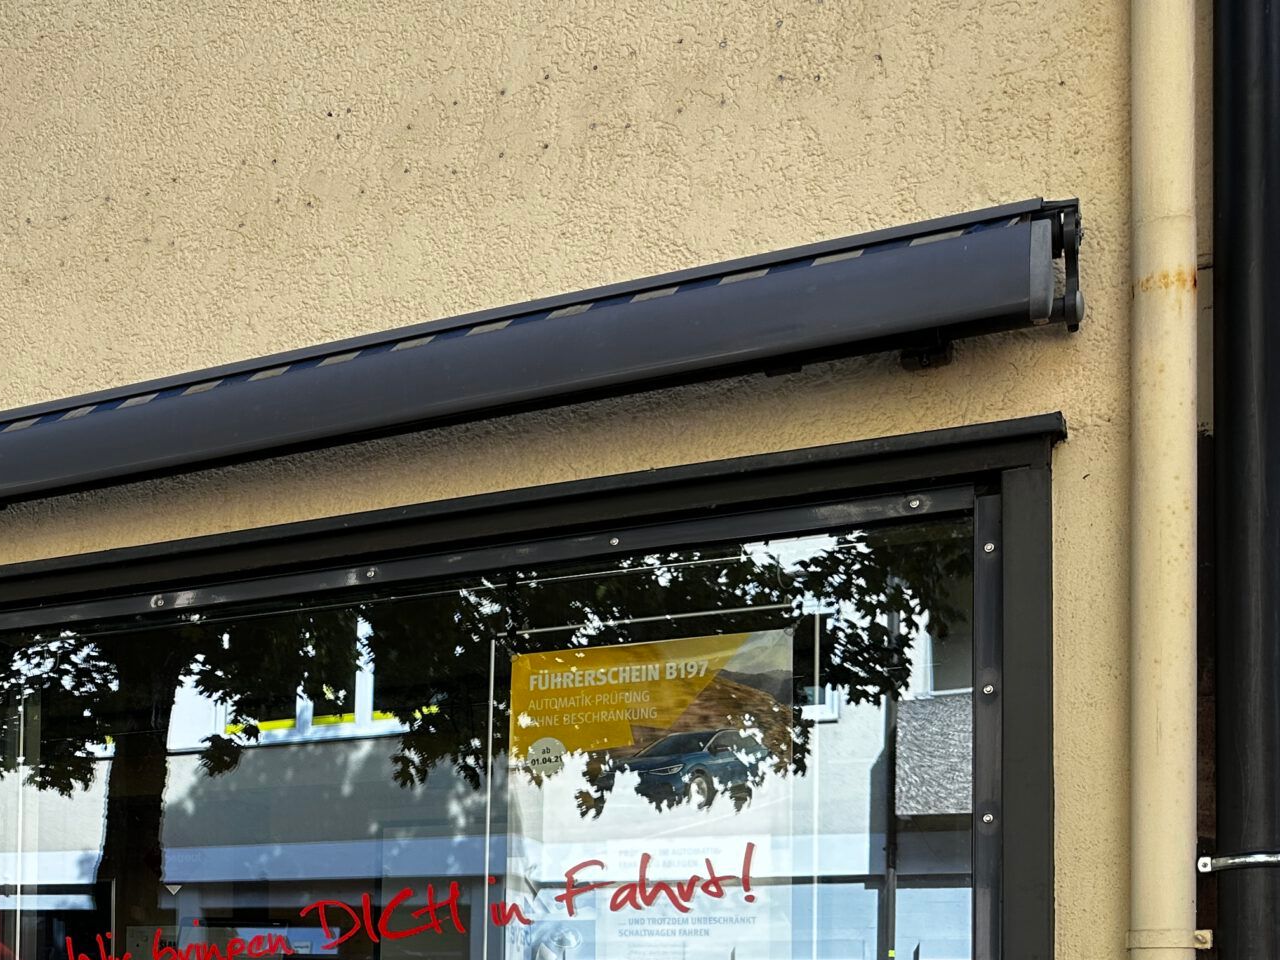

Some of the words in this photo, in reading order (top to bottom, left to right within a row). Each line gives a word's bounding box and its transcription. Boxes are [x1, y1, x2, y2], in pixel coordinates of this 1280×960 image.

[529, 663, 660, 691] FÜHRERSCHEIN
[665, 661, 709, 680] B197
[528, 690, 650, 711] AUTOMATIK-PRÜFUNG
[562, 707, 657, 725] BESCHRÄNKUNG
[541, 746, 551, 755] ab
[531, 755, 562, 766] 01.04.21
[300, 881, 467, 951] DICH
[487, 876, 535, 927] in
[690, 914, 758, 926] UNBESCHRÄNKT
[618, 928, 678, 938] SCHALTWAGEN
[678, 928, 710, 938] FAHREN
